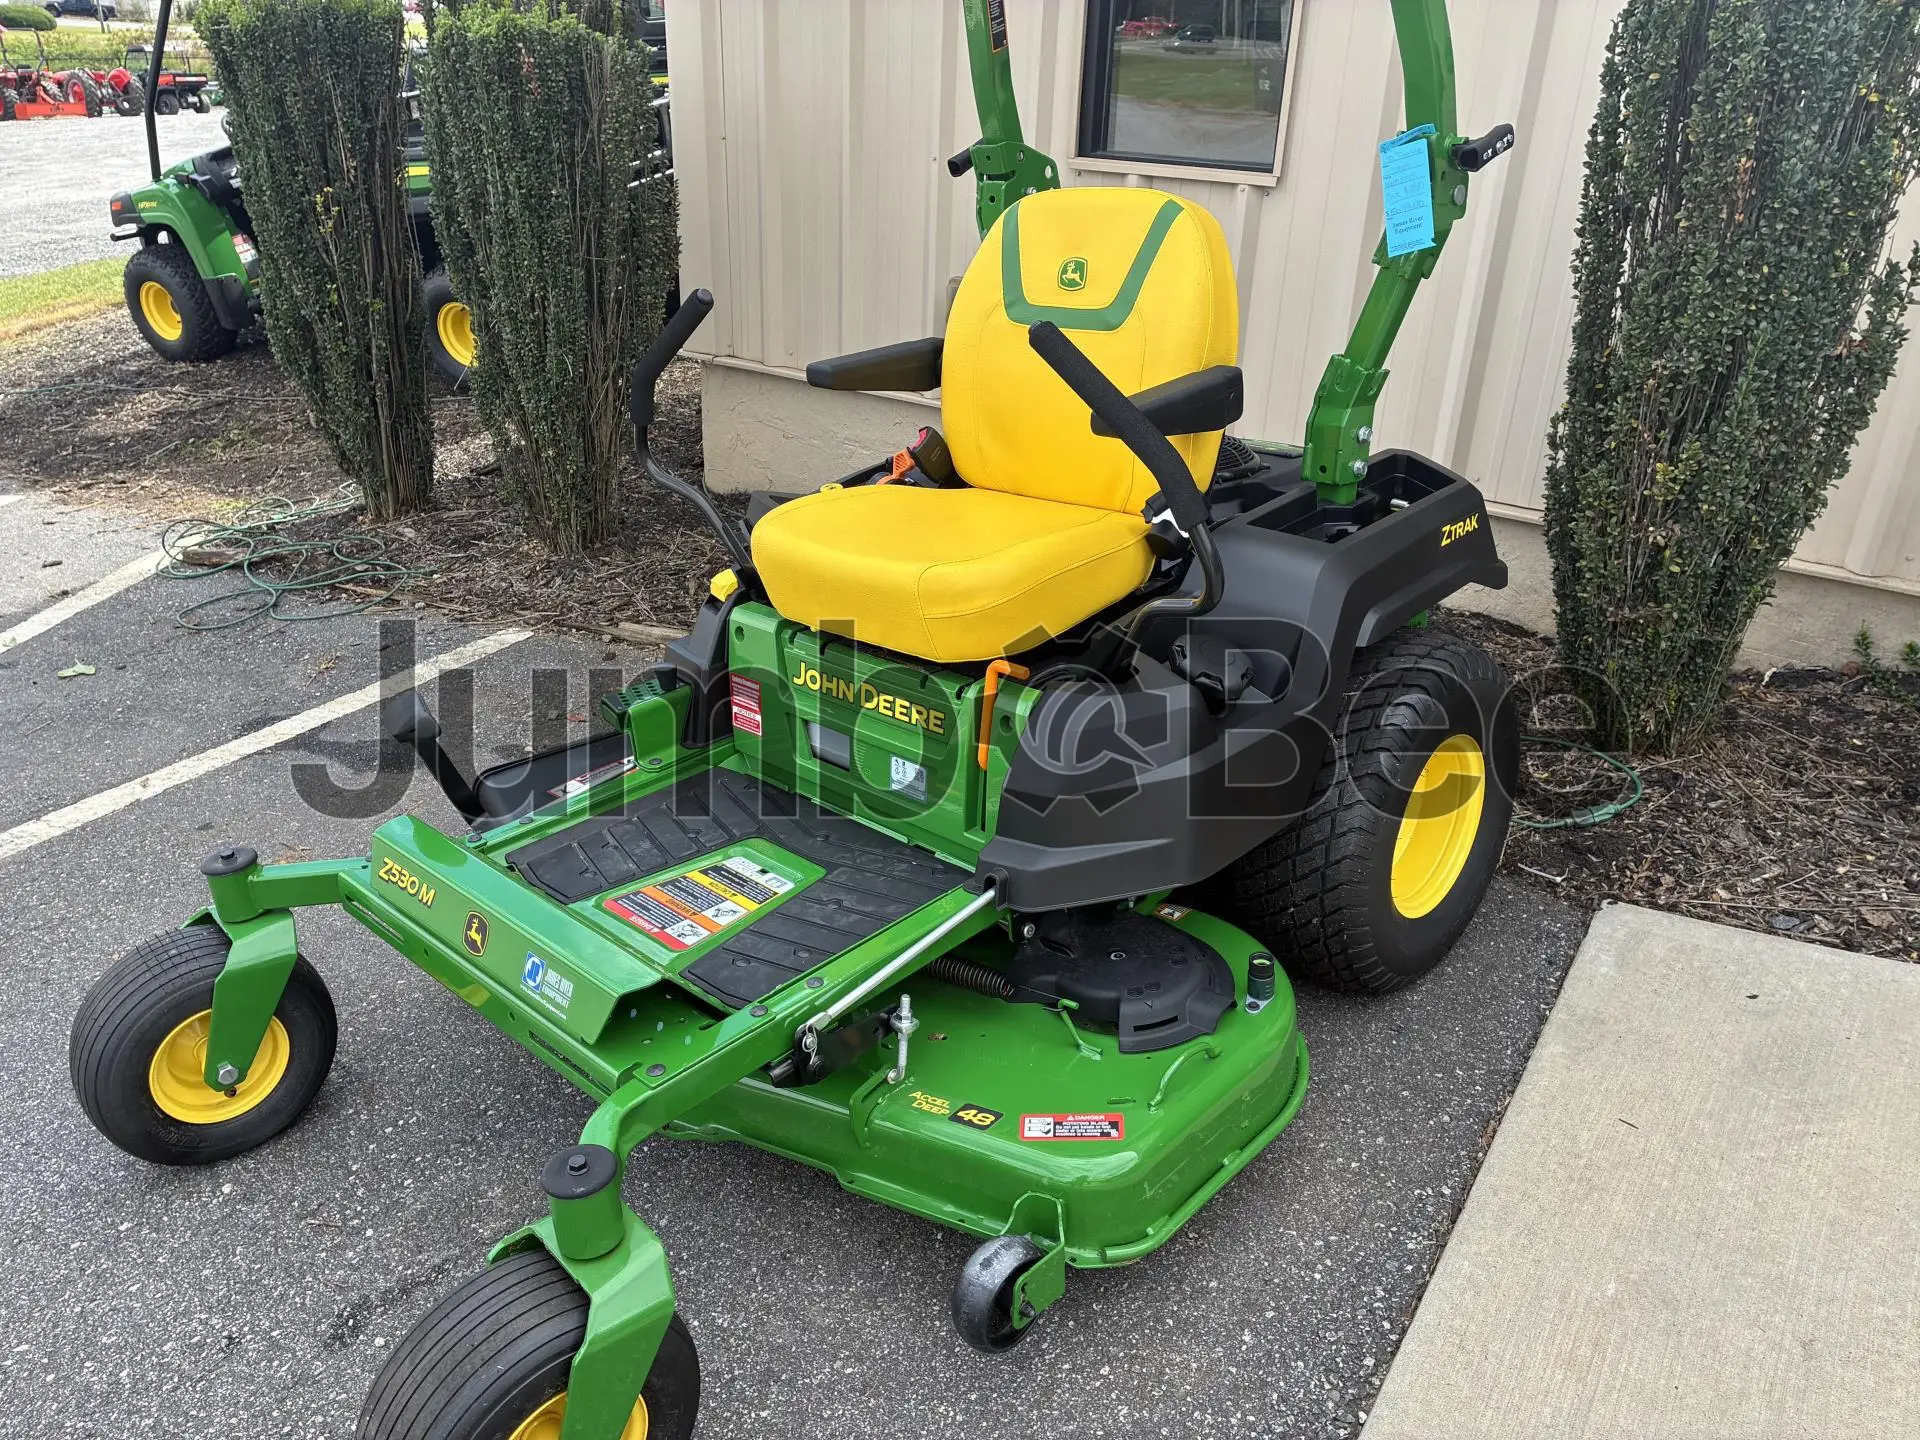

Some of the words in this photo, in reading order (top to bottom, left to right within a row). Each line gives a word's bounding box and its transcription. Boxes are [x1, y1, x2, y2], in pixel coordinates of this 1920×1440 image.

[1440, 513, 1479, 547] ZTRAK
[792, 661, 855, 705] JOHN
[859, 682, 946, 736] DEERE
[908, 1090, 951, 1109] ACCEL
[911, 1099, 951, 1116] DEEP
[956, 1109, 996, 1126] 48
